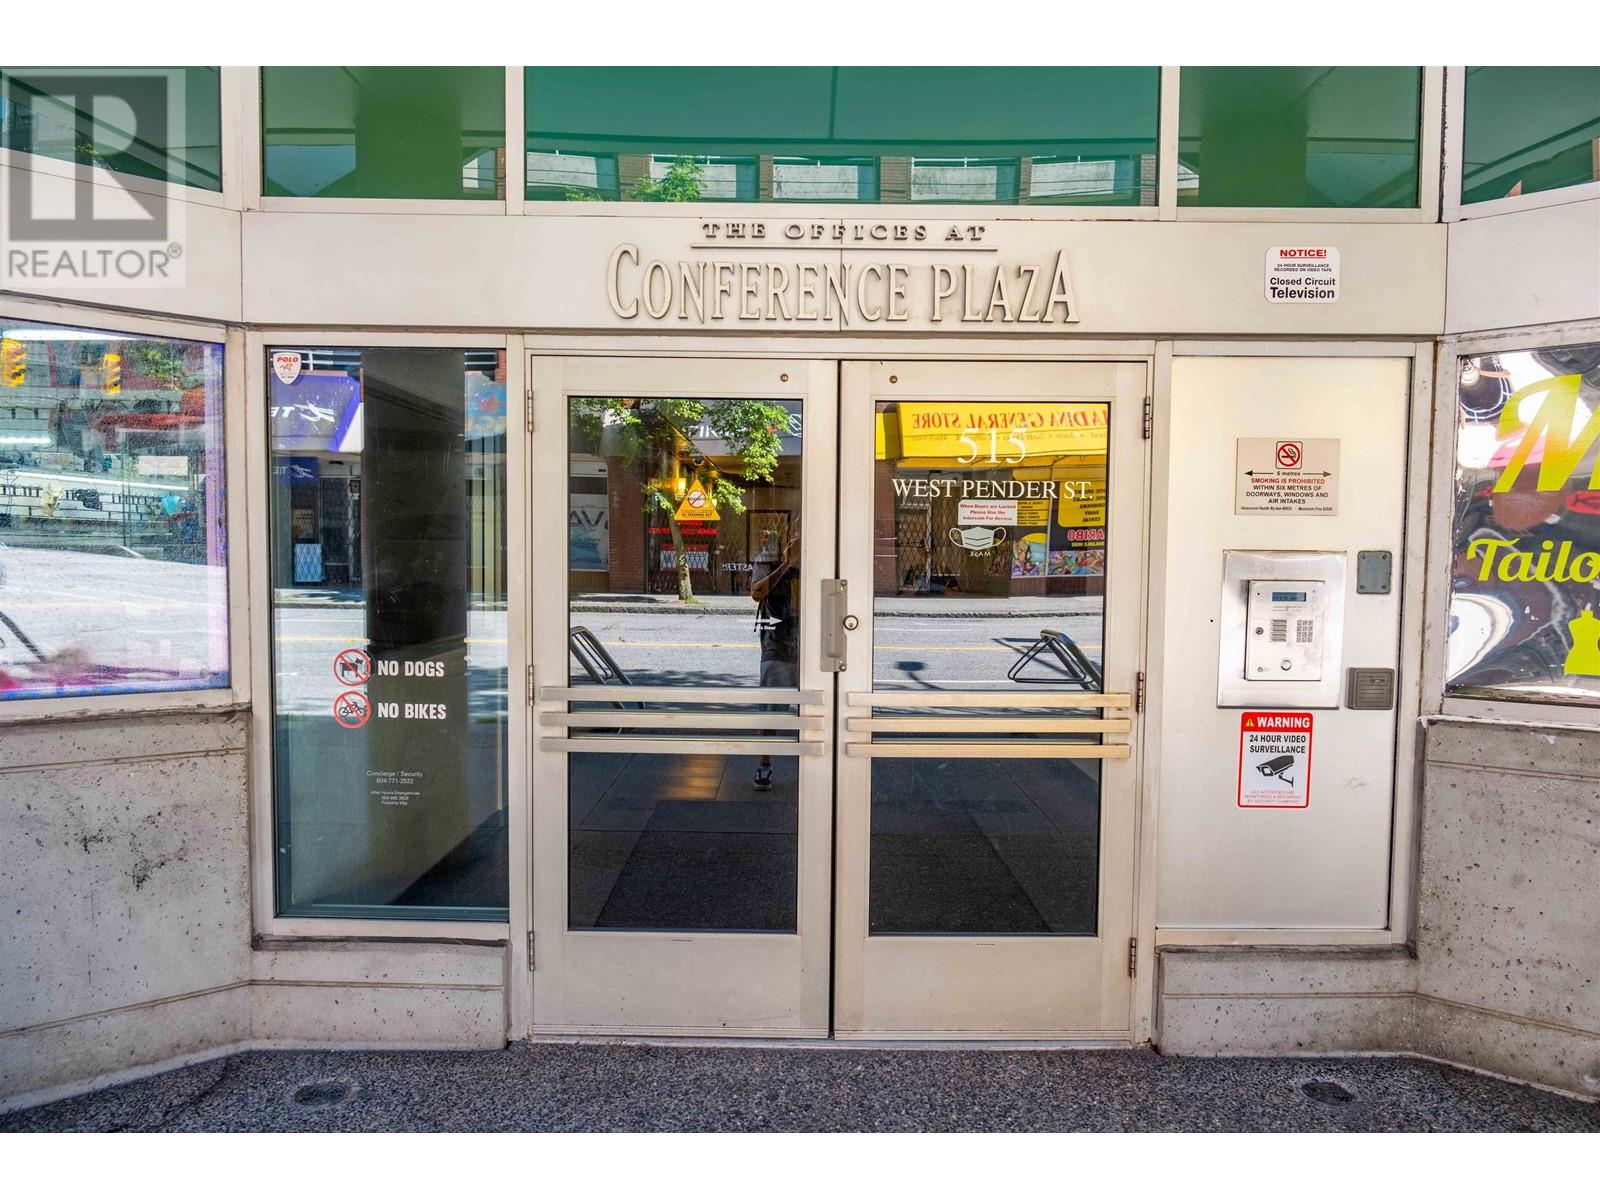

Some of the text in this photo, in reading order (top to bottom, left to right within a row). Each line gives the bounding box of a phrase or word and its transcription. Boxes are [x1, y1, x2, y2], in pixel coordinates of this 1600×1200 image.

[702, 222, 986, 242] THE OFFICES AT
[1280, 249, 1327, 257] NOTICE!
[606, 243, 1080, 325] CONFERENCE PLAZA
[1270, 287, 1335, 298] Television
[957, 428, 1026, 464] 515
[892, 478, 1093, 500] WEST PENDER ST.
[378, 660, 445, 677] NO DOGS
[378, 702, 446, 719] NO BIKES
[1257, 717, 1310, 728] WARNING
[1250, 745, 1306, 753] SURVEILLANCE
